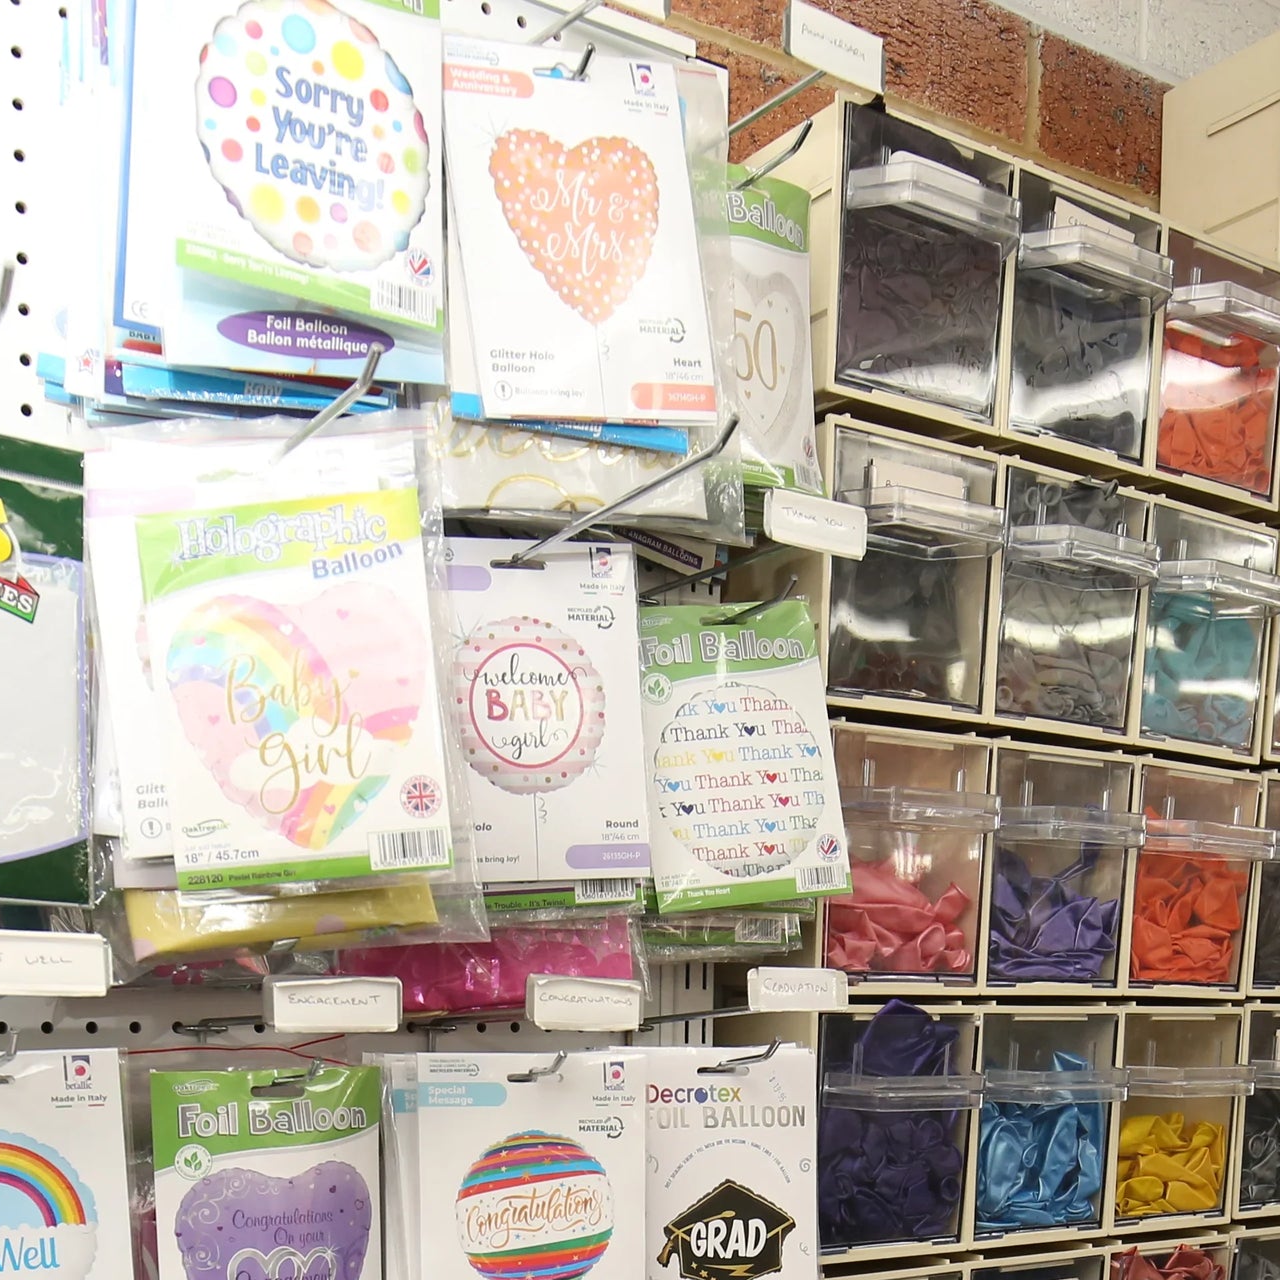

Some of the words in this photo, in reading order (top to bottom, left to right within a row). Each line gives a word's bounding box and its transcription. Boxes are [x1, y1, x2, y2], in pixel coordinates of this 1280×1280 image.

[450, 66, 499, 82] Wedding
[275, 66, 365, 126] Sorry
[453, 78, 518, 96] Anniversary
[272, 106, 368, 162] You're
[254, 143, 384, 211] Leaving!
[529, 170, 602, 219] Mr
[609, 193, 630, 221] &
[727, 191, 804, 250] Balloon
[546, 222, 625, 277] Mrs
[266, 315, 293, 330] Foil
[296, 318, 347, 335] Balloon
[247, 330, 293, 345] Ballon
[296, 334, 368, 353] métallique
[490, 349, 525, 361] Glitter
[673, 357, 702, 368] Heart
[491, 362, 536, 374] Balloon
[172, 504, 388, 563] Holographic
[312, 541, 404, 580] Balloon
[568, 613, 609, 623] MATERIAL
[642, 638, 691, 667] Foil
[700, 631, 806, 663] Balloon
[224, 654, 359, 738] Baby
[485, 689, 568, 722] BABY
[738, 744, 793, 762] Thank
[606, 820, 639, 828] Round
[494, 901, 522, 909] Trouble
[288, 992, 382, 1008] ENGAGEMENT
[428, 1085, 466, 1096] Special
[428, 1095, 473, 1105] Message
[646, 1083, 741, 1104] Decrotex
[177, 1101, 239, 1139] Foil
[248, 1096, 366, 1134] Balloon
[578, 1122, 619, 1133] MATERIAL
[703, 1104, 806, 1129] BALLOON
[231, 1208, 334, 1231] Congratulations
[465, 1184, 604, 1250] Congratulations
[273, 1227, 296, 1245] On
[299, 1230, 327, 1248] your
[690, 1218, 768, 1259] GRAD
